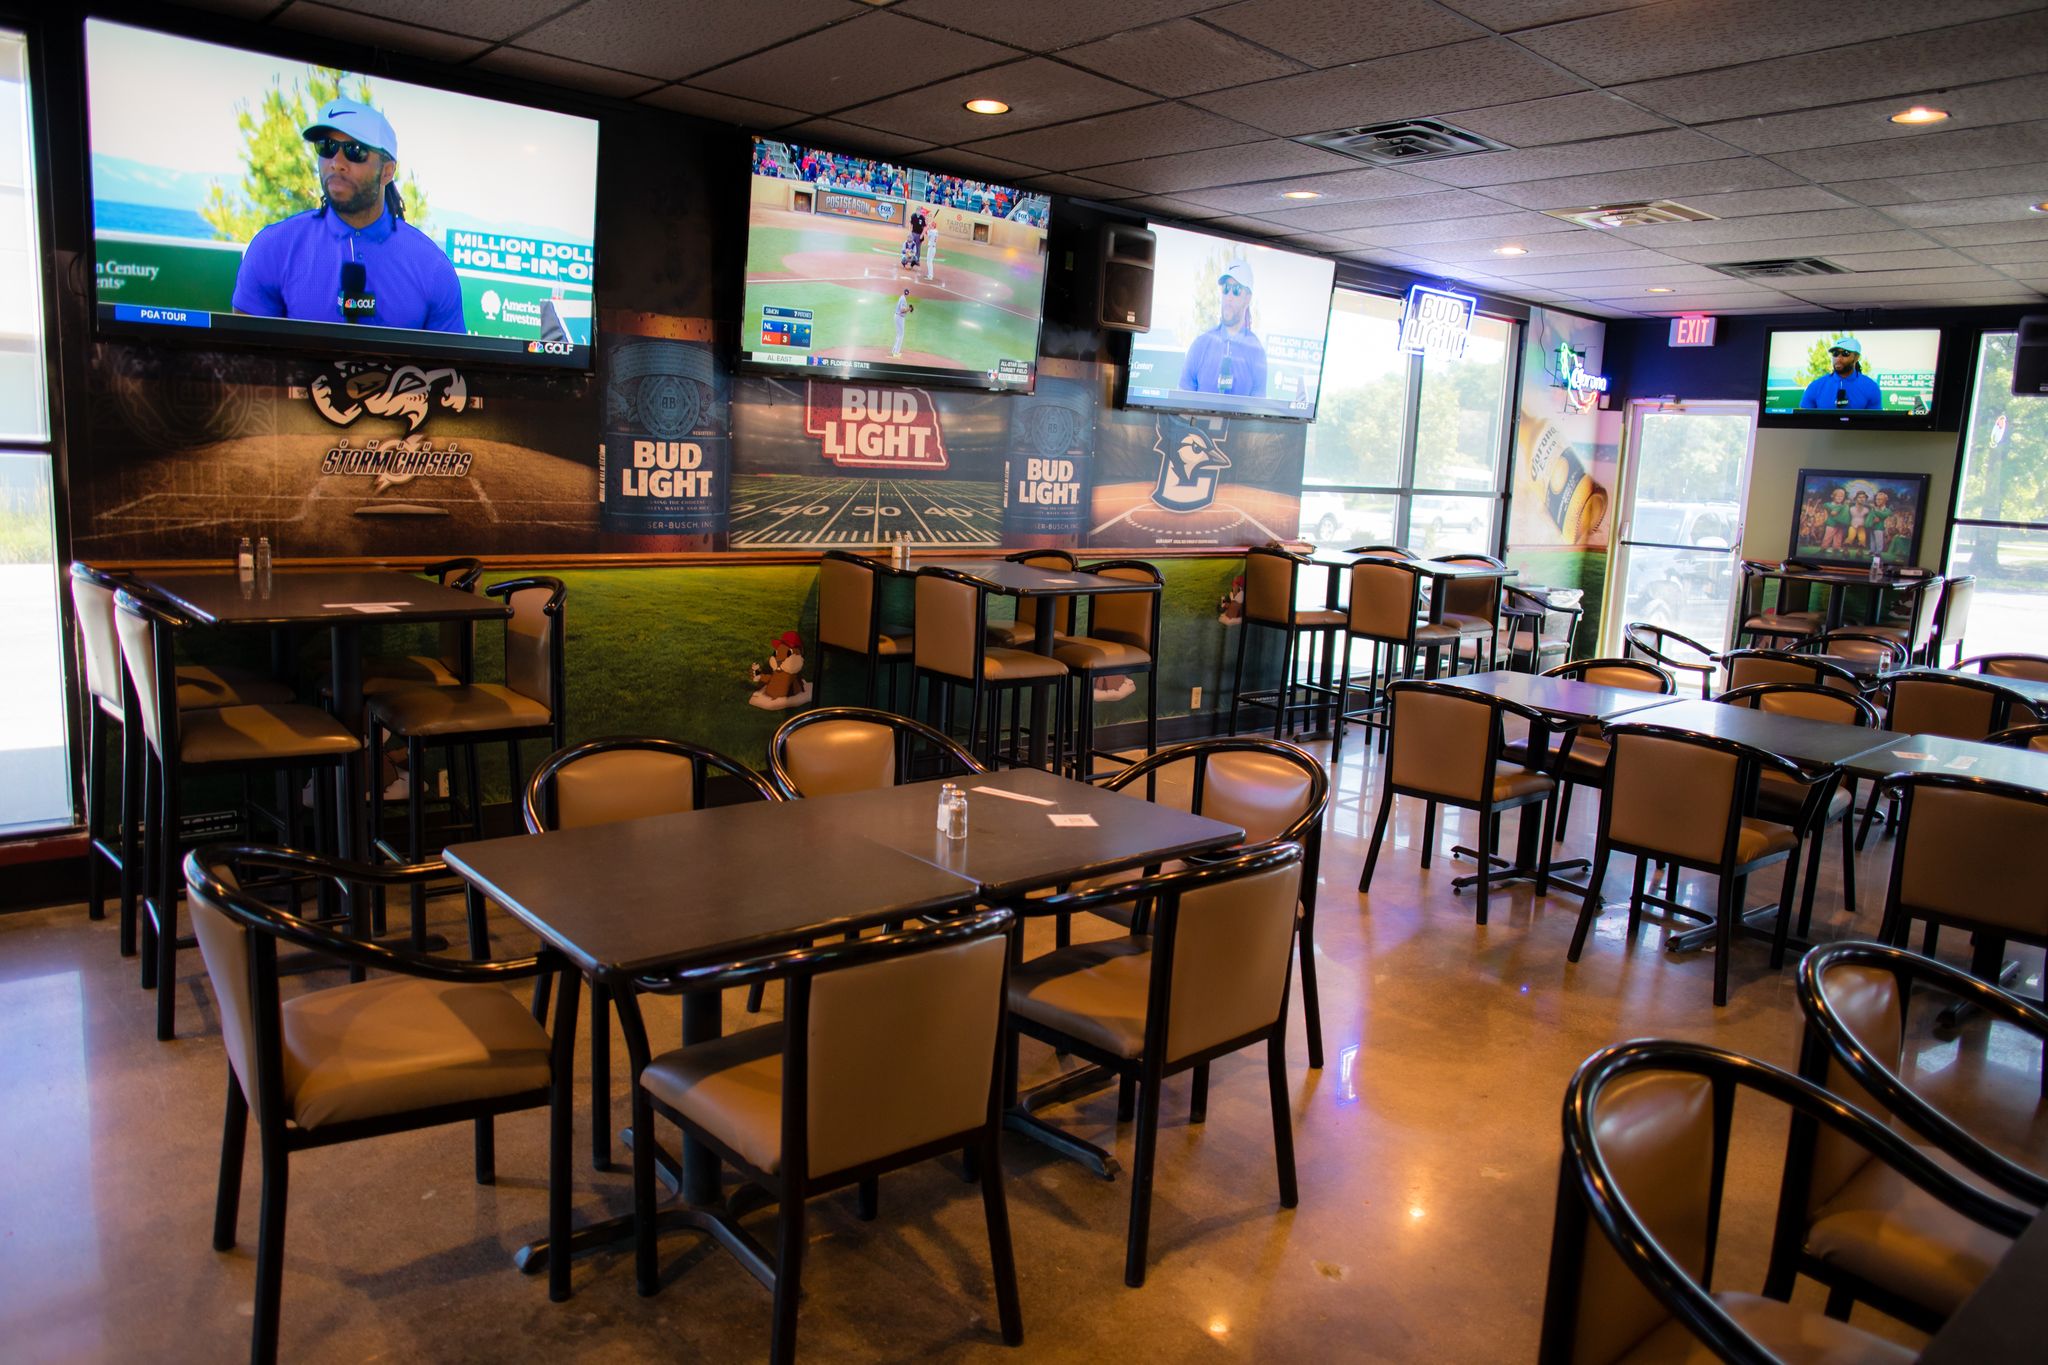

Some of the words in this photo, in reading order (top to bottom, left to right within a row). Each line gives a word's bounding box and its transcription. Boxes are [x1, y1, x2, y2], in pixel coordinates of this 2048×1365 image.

[454, 232, 536, 255] MILLION
[541, 243, 593, 262] DOLL
[105, 260, 160, 281] Century
[453, 247, 593, 280] HOLE-IN-O
[140, 309, 160, 320] PGA
[161, 311, 187, 322] TOUR
[357, 299, 376, 309] GOLF
[1421, 294, 1464, 324] BUD
[763, 322, 773, 330] NL
[782, 323, 788, 332] 2
[763, 334, 772, 342] AL
[782, 335, 788, 343] 3
[1405, 319, 1467, 354] LIGHT
[1677, 319, 1710, 344] EXIT
[544, 342, 574, 355] GOLF
[830, 359, 853, 368] FLORIDA
[853, 361, 871, 369] STATE
[1571, 367, 1607, 391] Corona
[841, 387, 918, 424] BUD
[825, 421, 932, 458] LIGHT
[321, 448, 392, 475] STORM
[391, 450, 473, 477] CHASERS
[634, 440, 703, 470] BUD
[1531, 426, 1560, 482] Corona
[1027, 458, 1074, 482] BUD
[622, 468, 713, 498] LIGHT
[1018, 480, 1081, 505] LIGHT
[769, 504, 830, 517] 40
[851, 505, 902, 517] 50
[924, 506, 974, 518] 40
